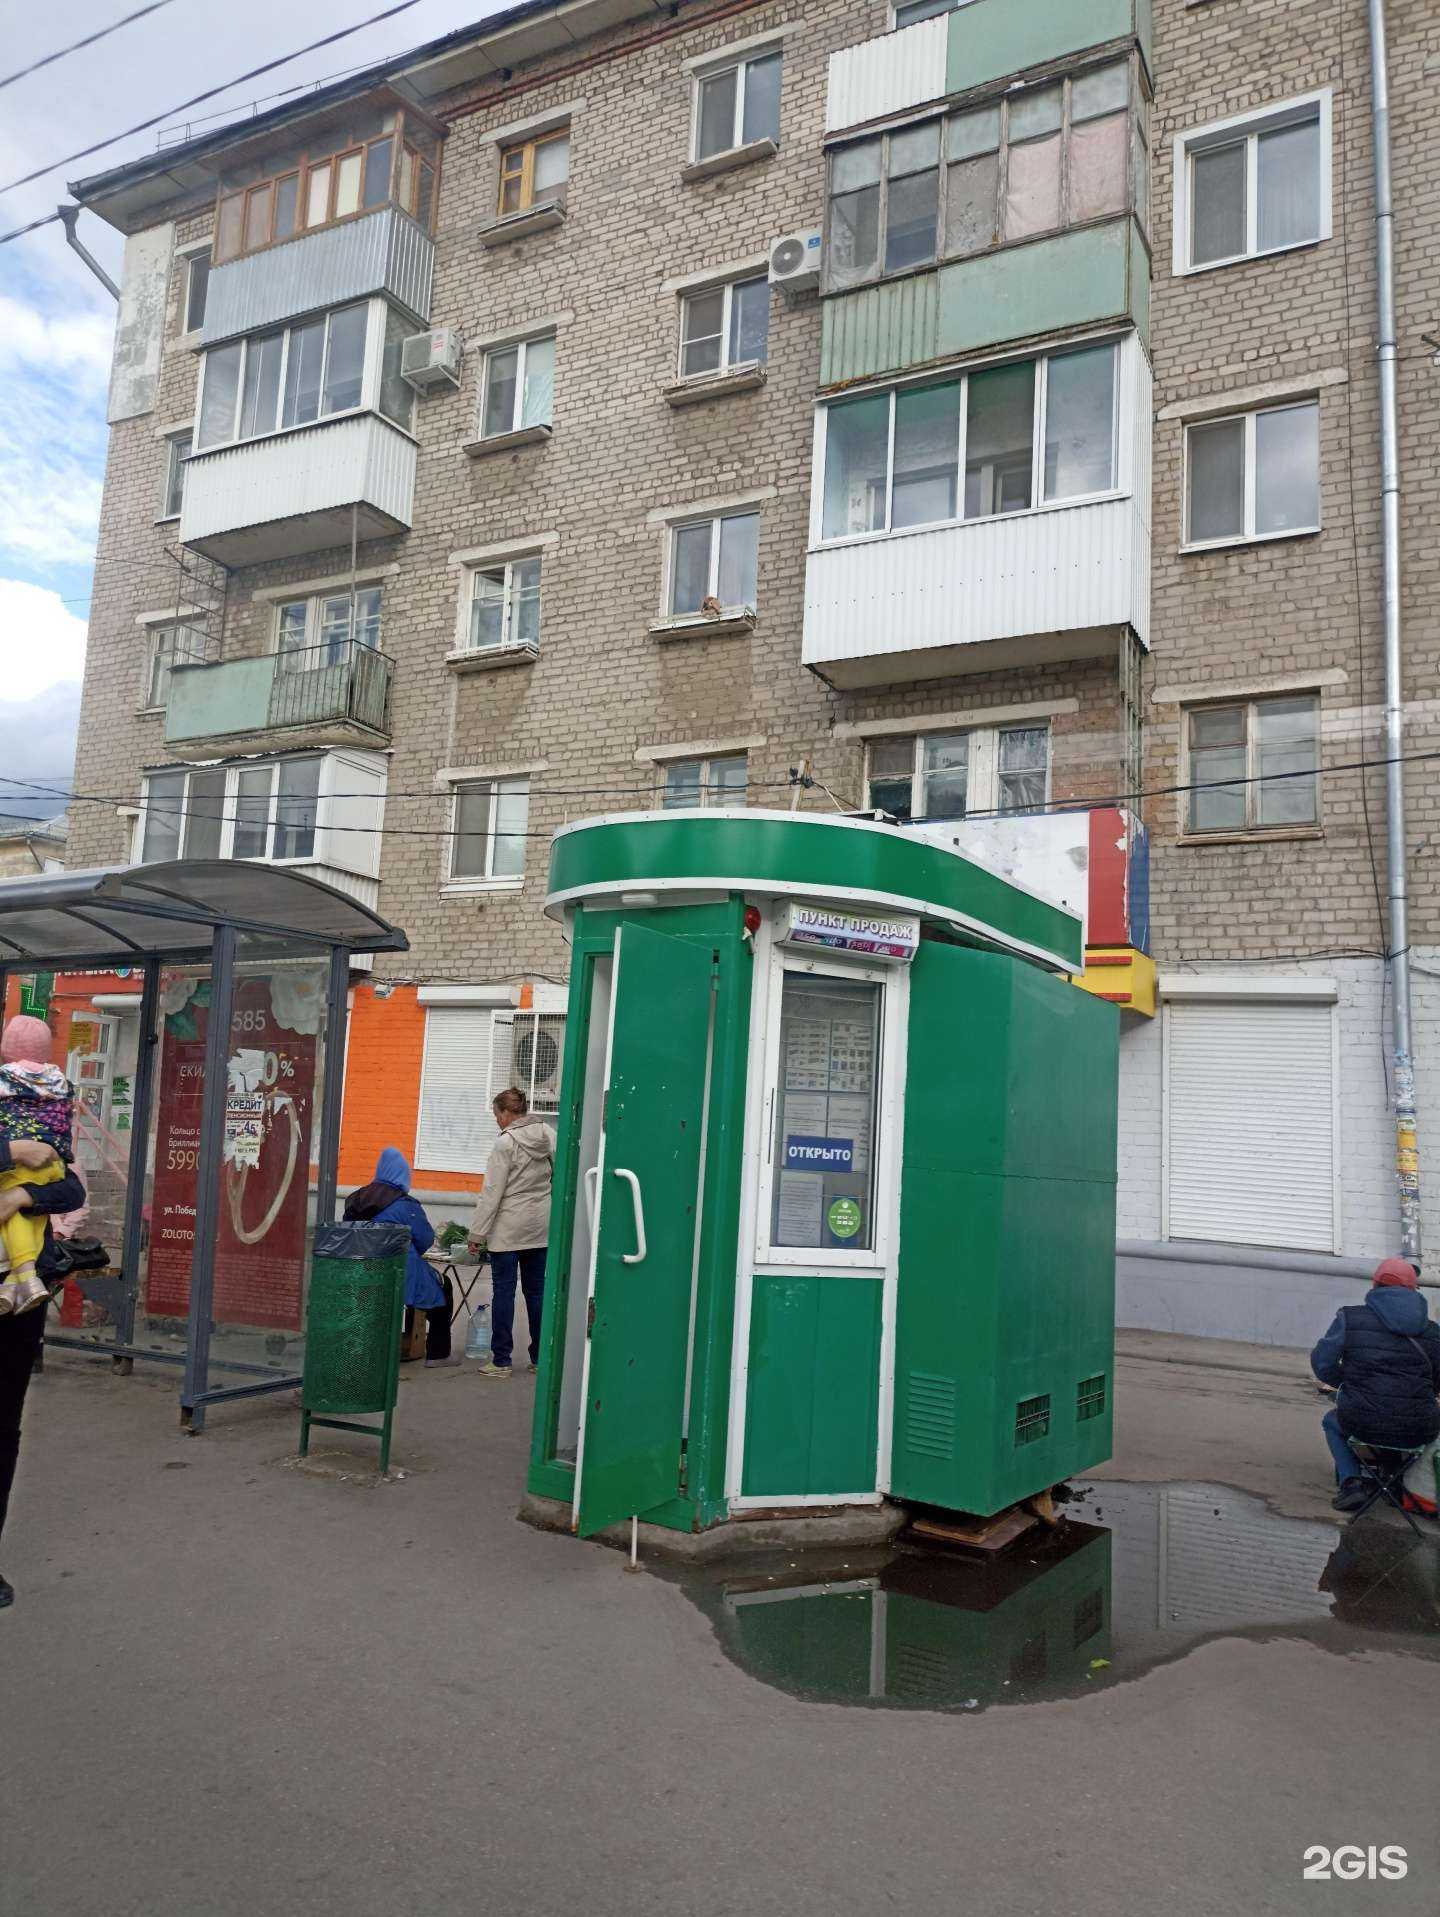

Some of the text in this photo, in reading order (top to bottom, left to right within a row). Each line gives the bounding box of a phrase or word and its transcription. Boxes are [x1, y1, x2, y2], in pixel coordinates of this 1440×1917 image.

[799, 909, 912, 939] ПУНКТ ПРОДАЖ
[231, 1010, 266, 1031] 585
[227, 1100, 263, 1111] КРЕДИТ
[169, 1124, 195, 1137] Кольцо
[168, 1137, 201, 1149] бриллиан
[788, 1145, 852, 1161] ОТКРЫТО
[175, 1204, 197, 1217] Побед
